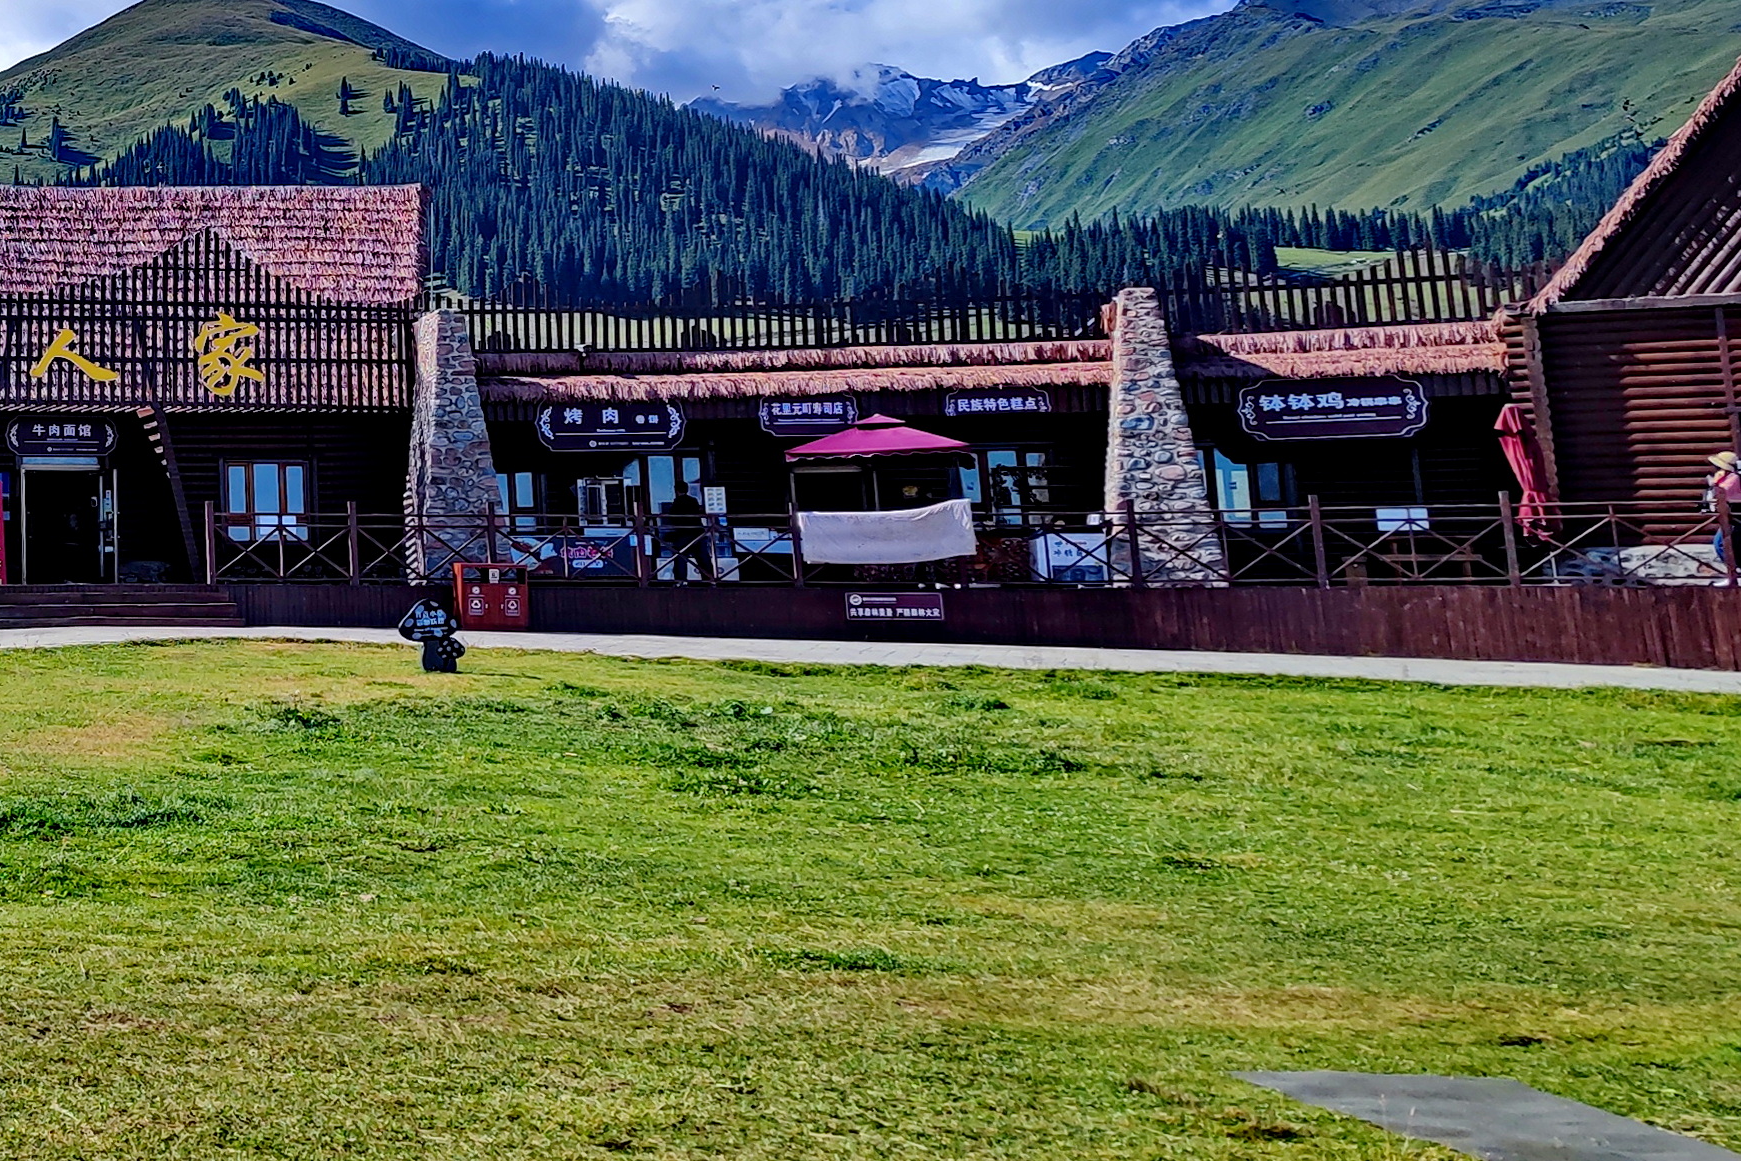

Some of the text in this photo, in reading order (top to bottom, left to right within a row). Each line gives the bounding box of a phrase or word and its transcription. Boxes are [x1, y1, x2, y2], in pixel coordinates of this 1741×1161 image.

[957, 396, 1038, 411] 民族特色糕点
[1259, 391, 1344, 412] 钵钵鸡
[563, 406, 619, 425] 烤肉
[31, 423, 92, 437] 牛肉面馆
